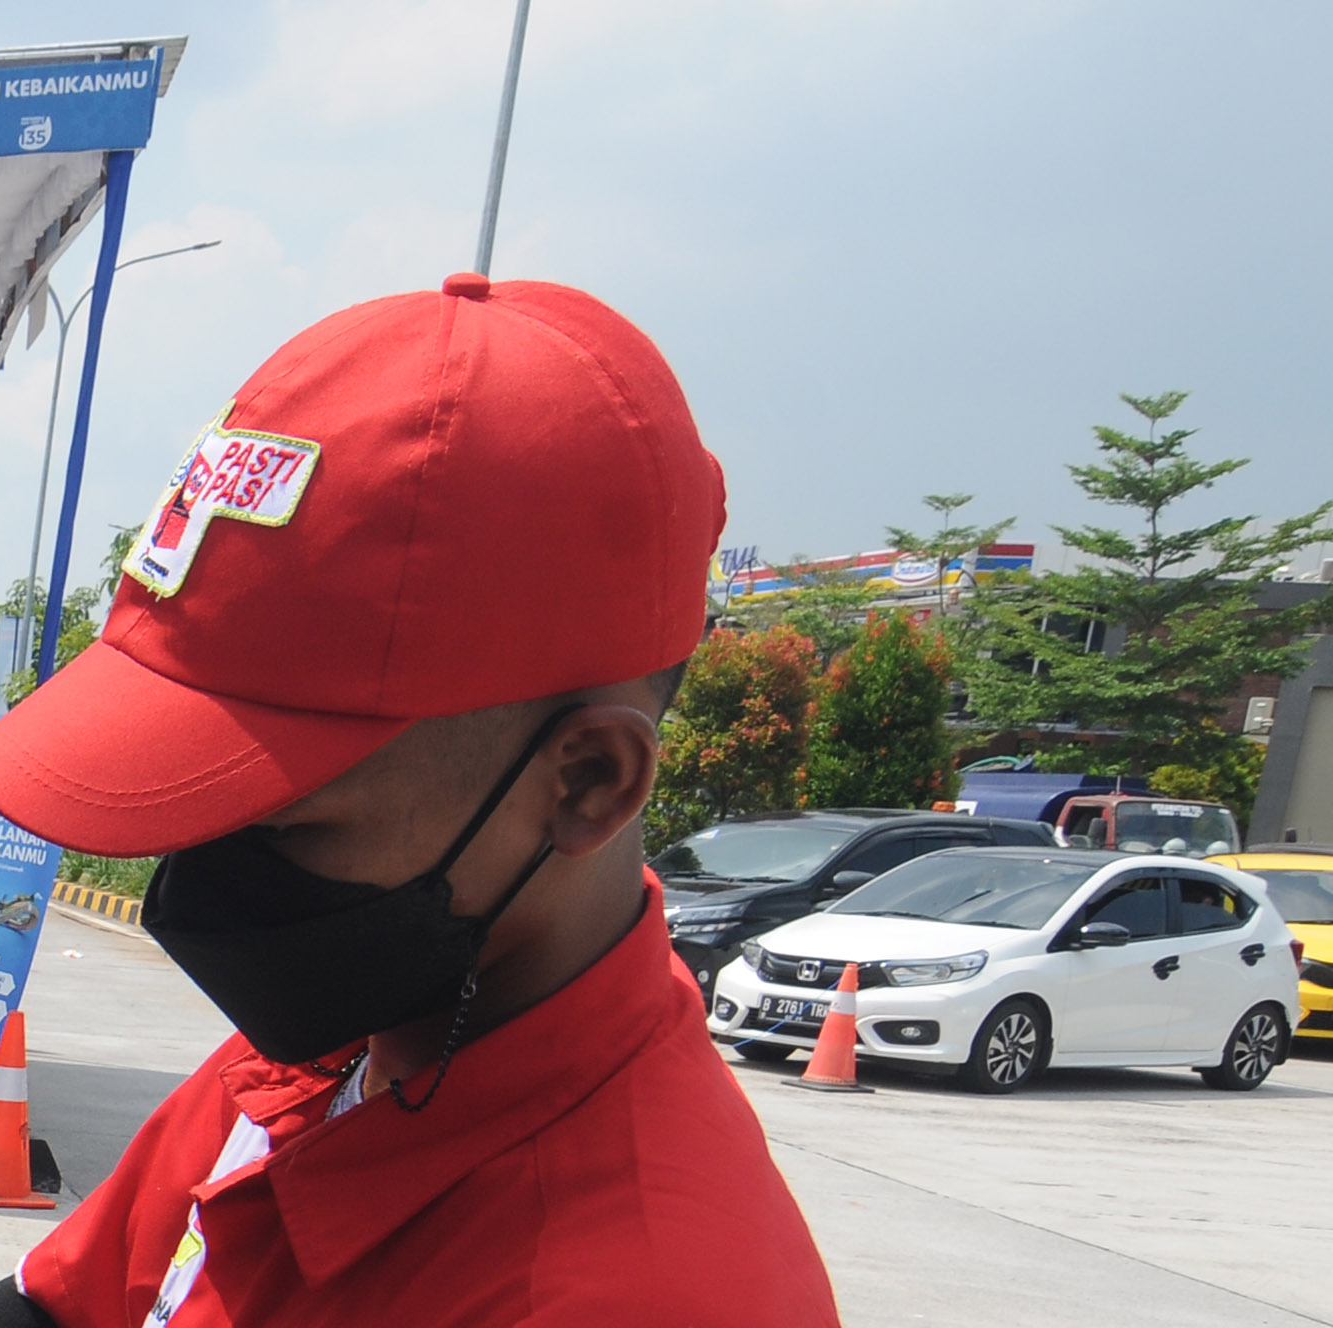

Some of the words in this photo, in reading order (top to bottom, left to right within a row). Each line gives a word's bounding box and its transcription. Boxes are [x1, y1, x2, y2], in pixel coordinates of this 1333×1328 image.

[4, 70, 149, 98] KEBAIKANMU
[214, 441, 308, 484] PASTI
[762, 997, 772, 1012] B
